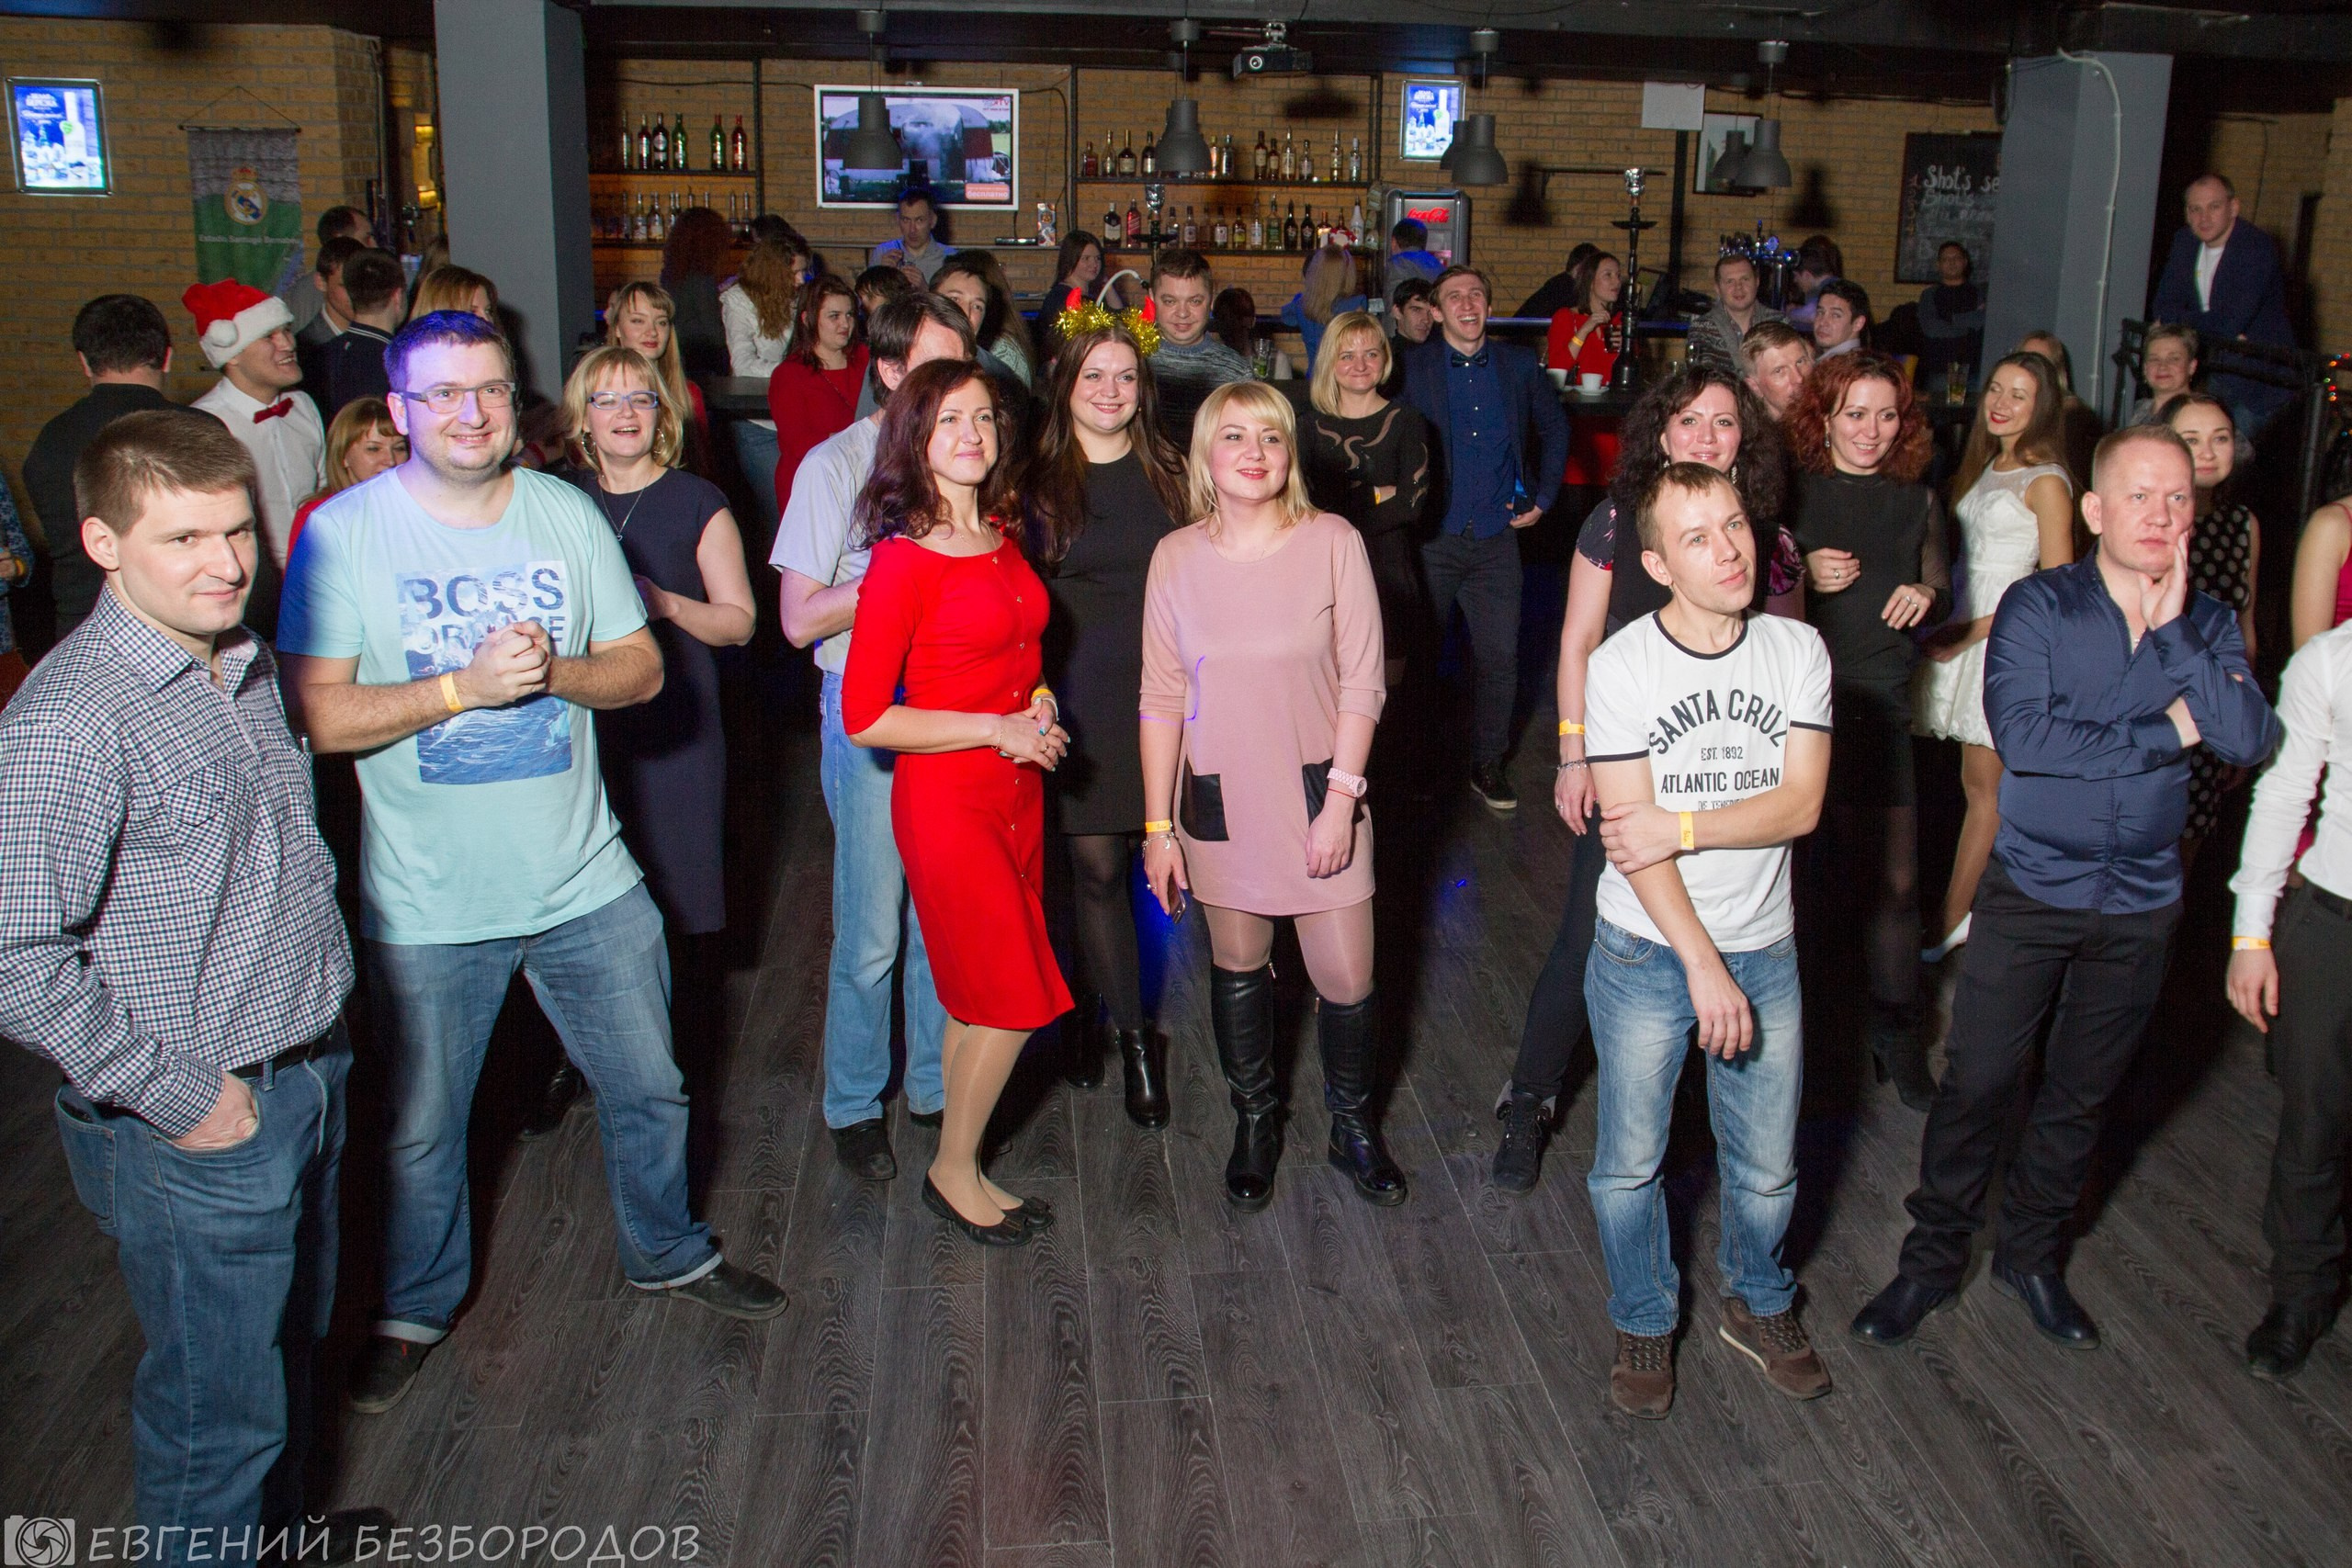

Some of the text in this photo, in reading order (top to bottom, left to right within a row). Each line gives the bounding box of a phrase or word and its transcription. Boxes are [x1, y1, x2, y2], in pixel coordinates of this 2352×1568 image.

[1924, 164, 2000, 192] Shot's se
[402, 567, 565, 620] BOSS
[401, 615, 566, 653] ORAE
[1648, 688, 1788, 755] SANTA CRUZ
[1701, 746, 1744, 761] EST. 1892
[1660, 767, 1781, 795] ATLANTIC OCEAN
